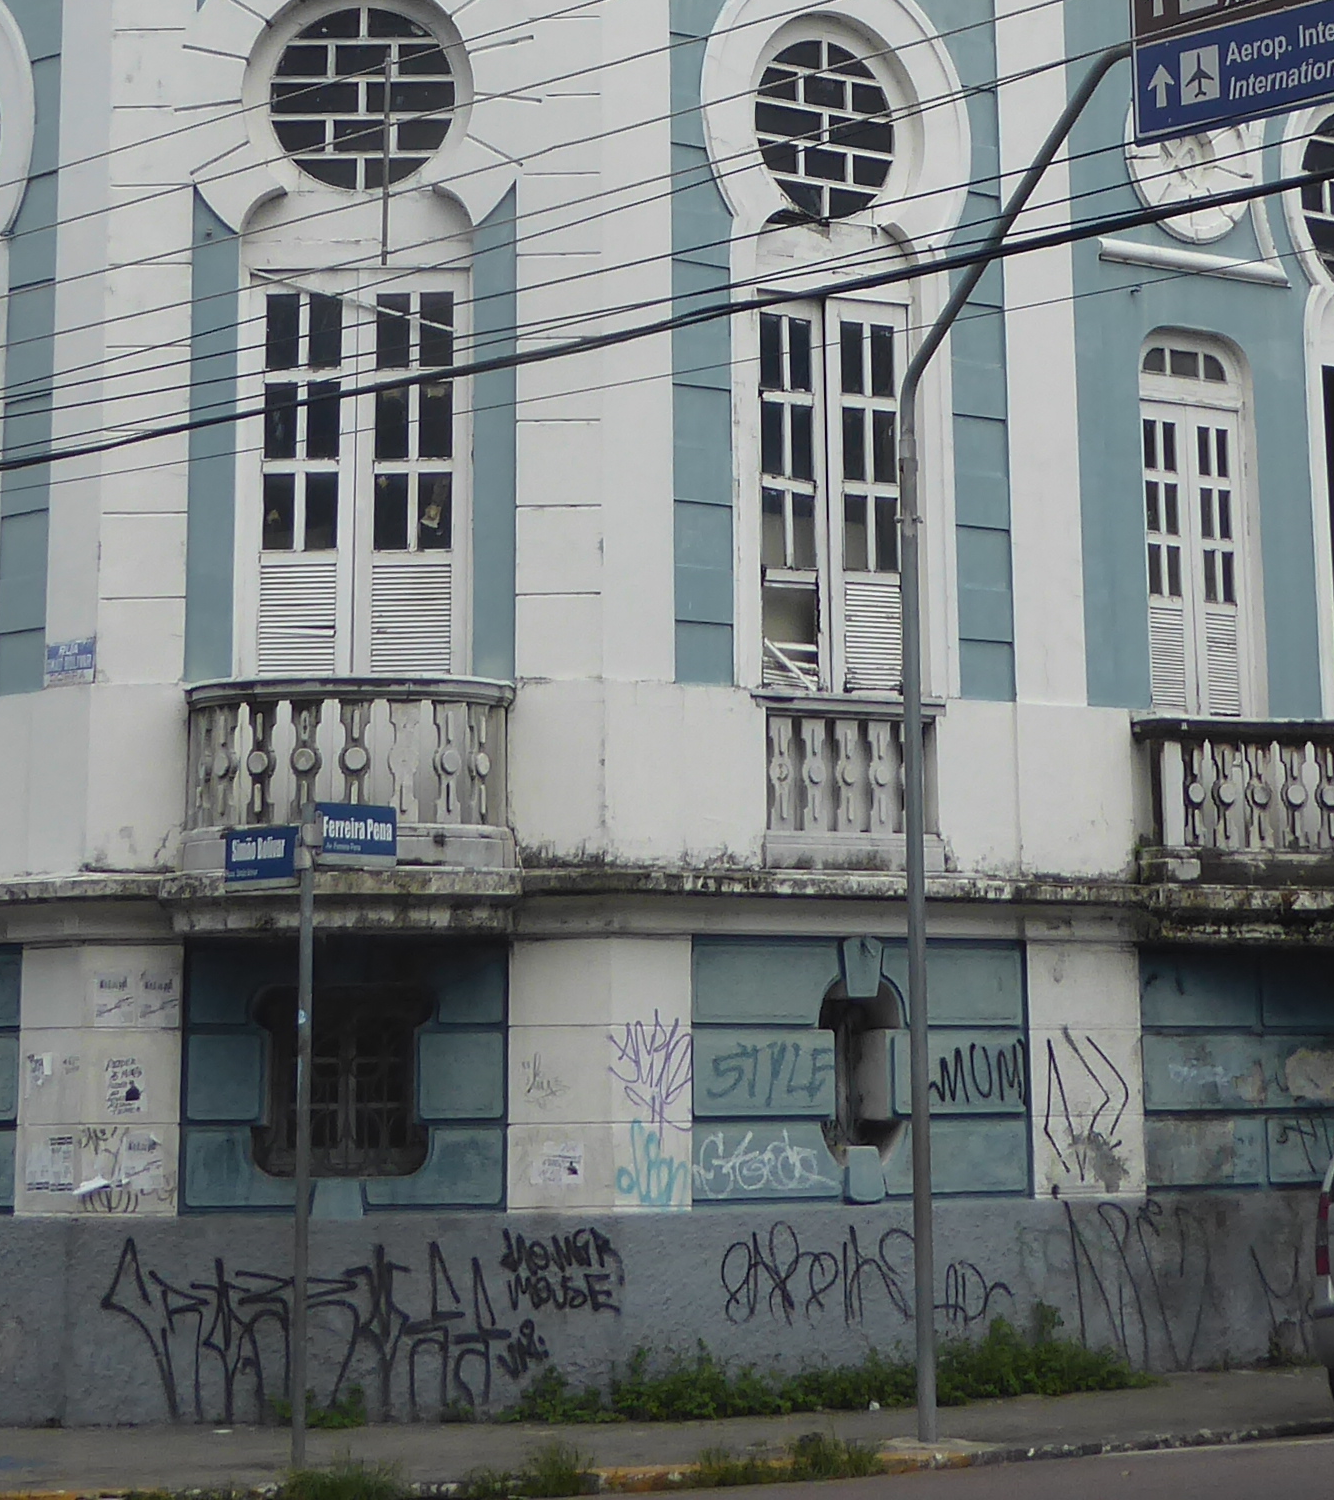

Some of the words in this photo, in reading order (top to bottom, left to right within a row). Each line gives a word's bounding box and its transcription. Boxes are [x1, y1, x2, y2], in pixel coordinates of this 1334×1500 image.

[1226, 35, 1292, 66] Aerop.
[323, 815, 365, 840] Ferreira
[367, 818, 393, 842] Pena
[707, 1040, 834, 1107] STYLE
